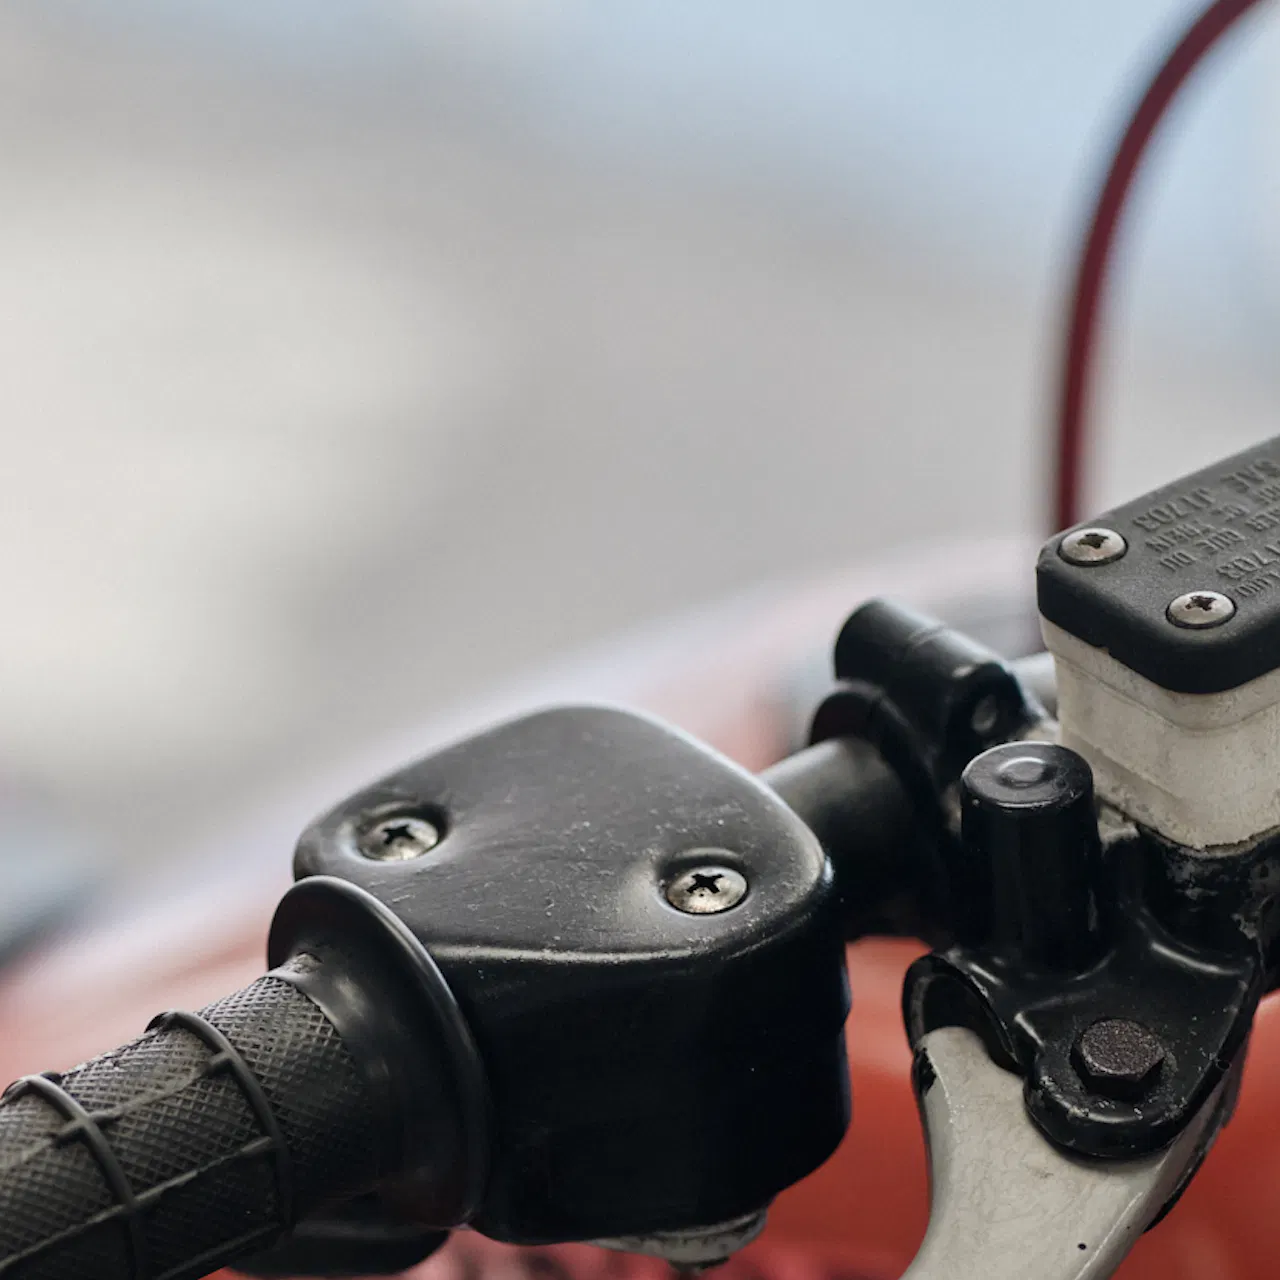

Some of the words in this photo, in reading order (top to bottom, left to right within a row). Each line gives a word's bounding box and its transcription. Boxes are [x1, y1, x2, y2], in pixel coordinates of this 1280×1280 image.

[1128, 487, 1220, 533] J1703
[1194, 528, 1245, 554] QUE
[1154, 550, 1197, 573] DU
